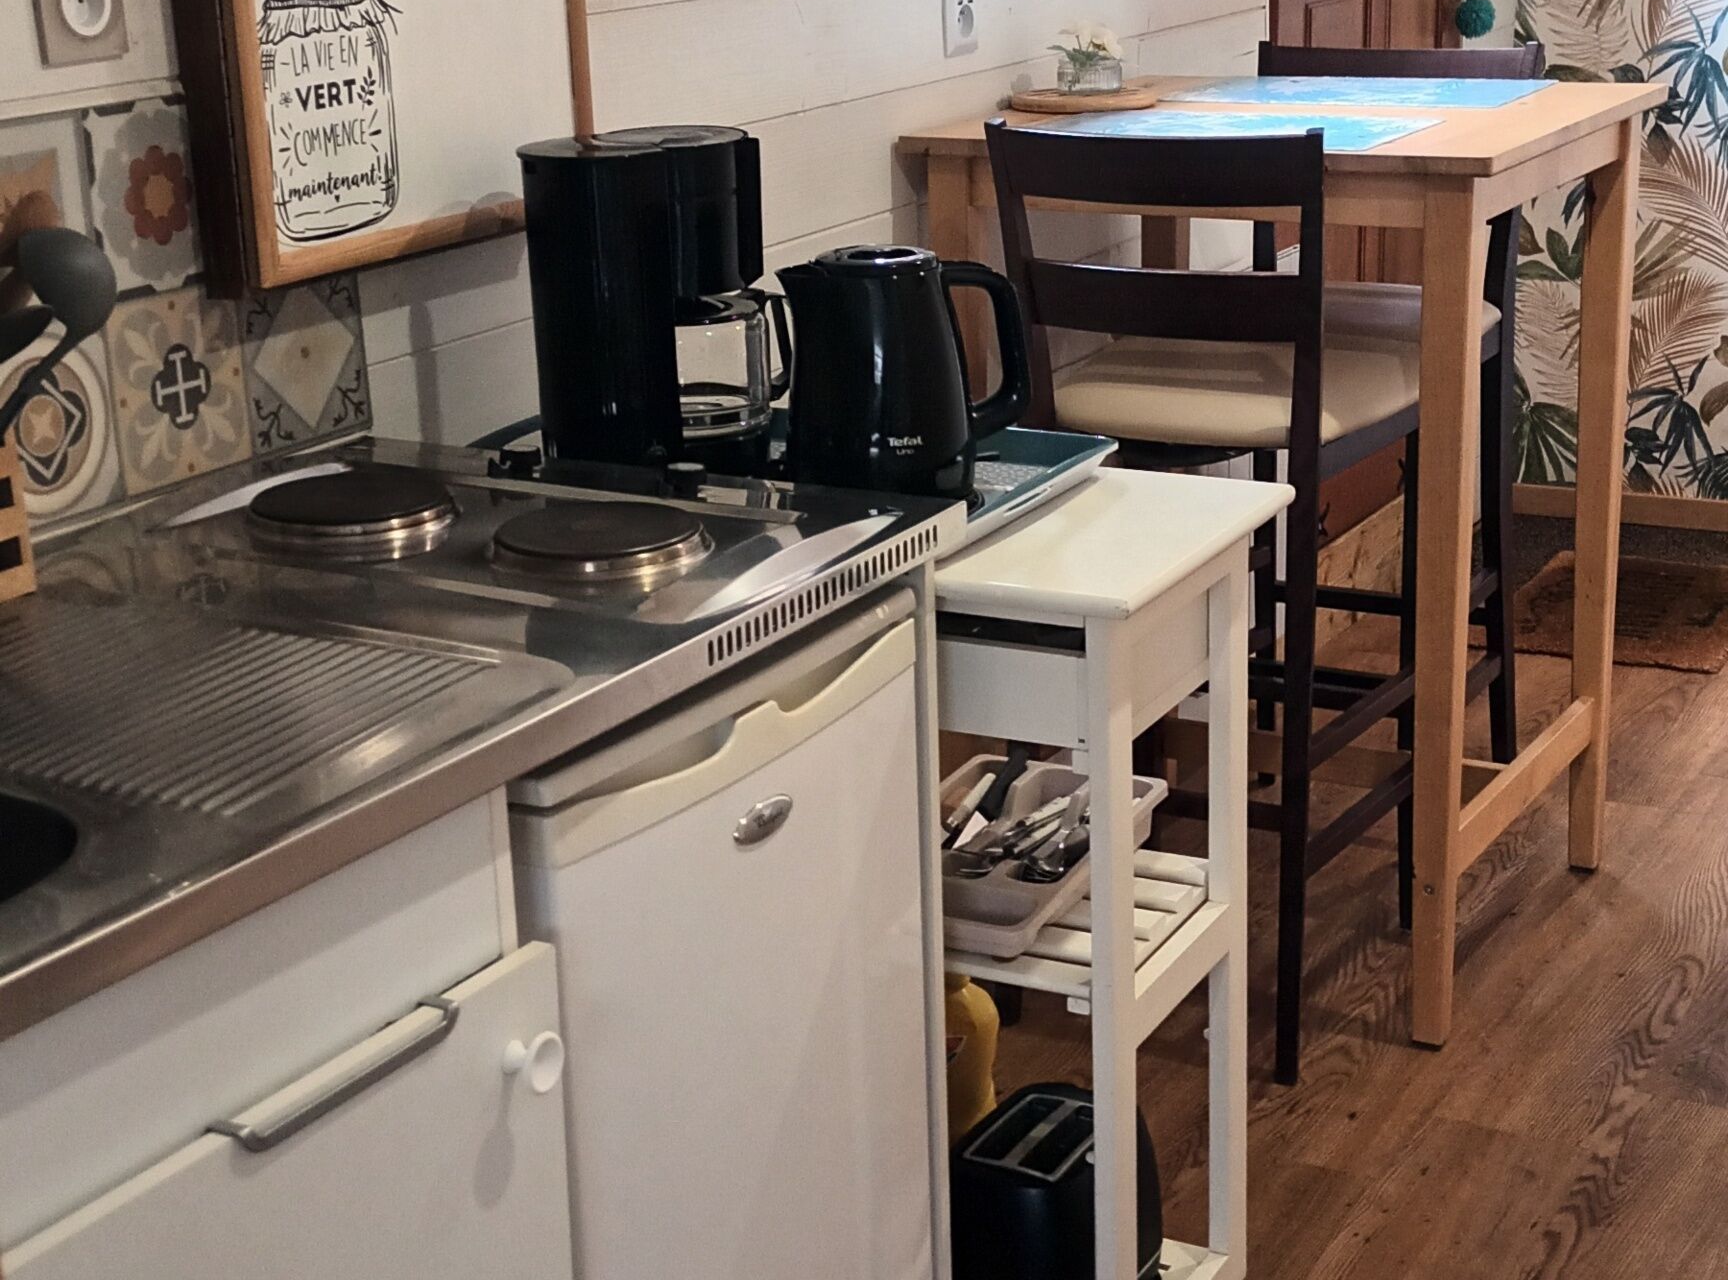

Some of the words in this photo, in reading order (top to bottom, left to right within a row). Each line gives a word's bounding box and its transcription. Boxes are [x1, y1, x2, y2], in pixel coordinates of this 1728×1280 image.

[291, 43, 310, 77] LA
[314, 40, 335, 71] VIE
[339, 35, 358, 67] EN
[295, 78, 356, 112] VERT
[293, 118, 367, 167] COMMENCE
[887, 436, 923, 447] Tefal
